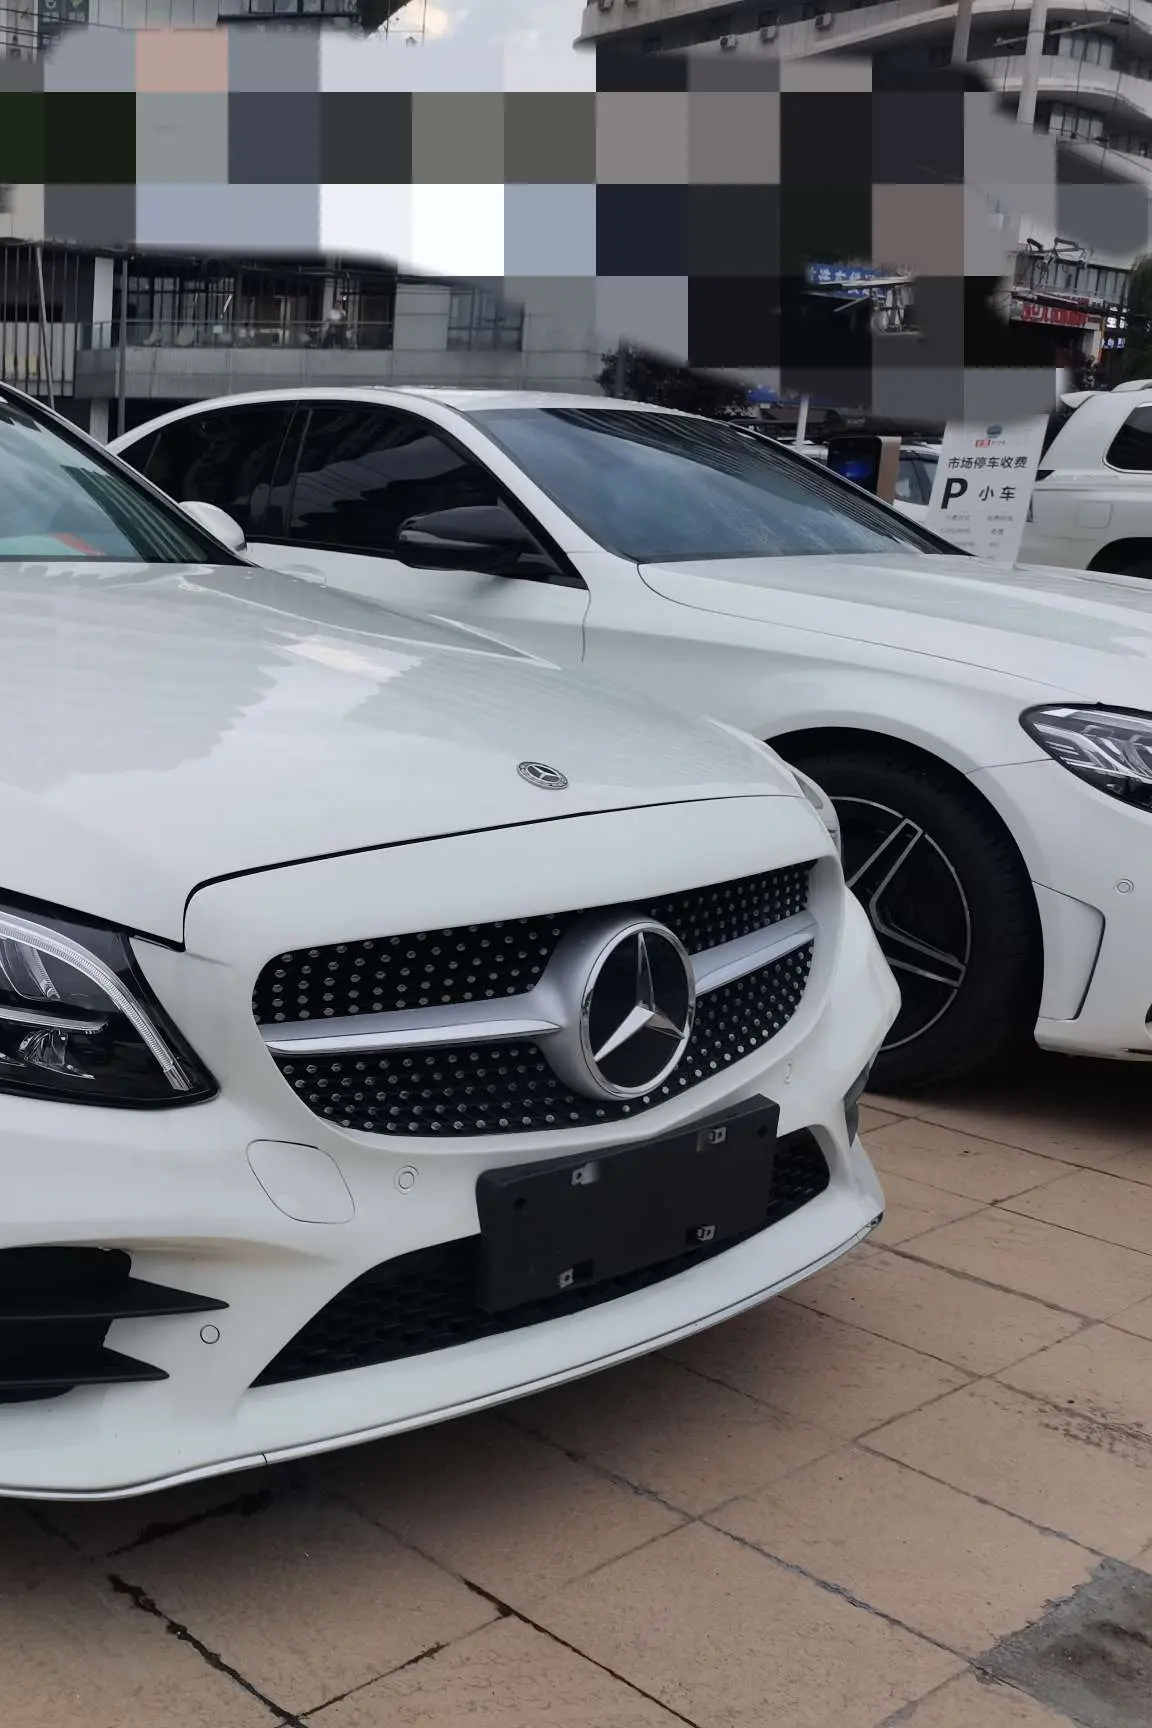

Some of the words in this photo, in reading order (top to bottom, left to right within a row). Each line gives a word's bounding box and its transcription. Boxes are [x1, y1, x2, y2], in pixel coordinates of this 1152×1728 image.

[948, 456, 1027, 470] 市场停车收费
[941, 477, 968, 510] P
